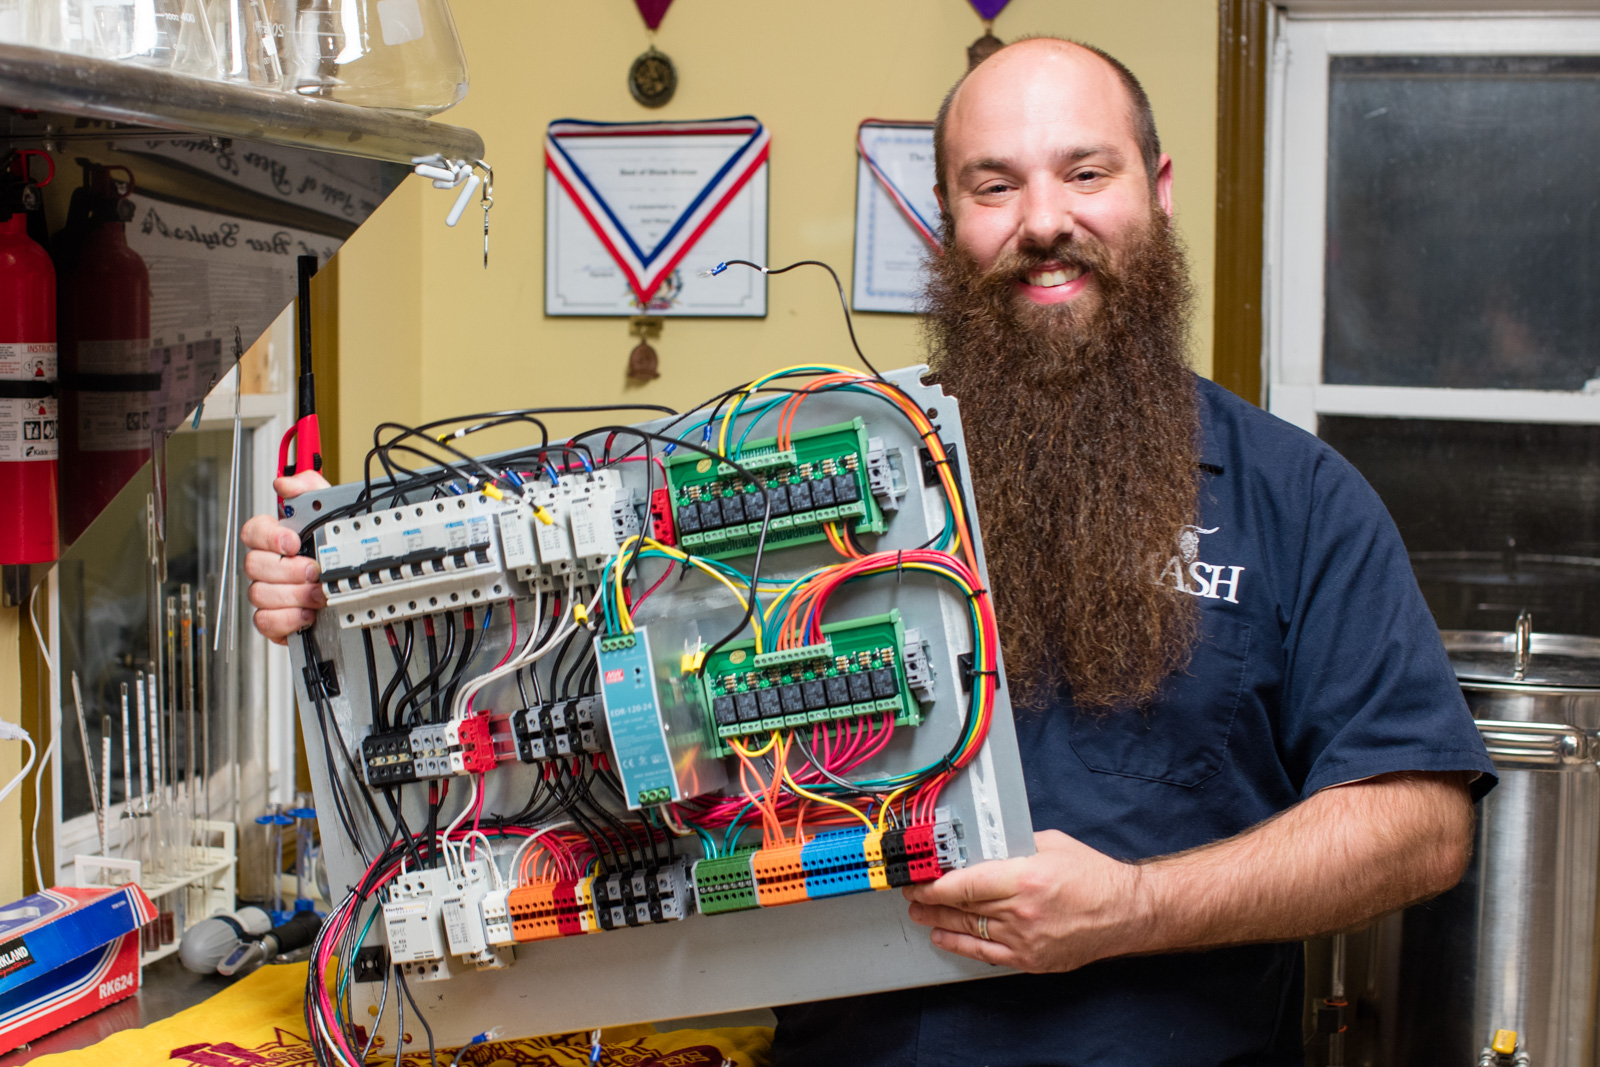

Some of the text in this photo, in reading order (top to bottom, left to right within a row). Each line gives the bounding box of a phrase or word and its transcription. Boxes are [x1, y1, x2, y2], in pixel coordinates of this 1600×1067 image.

[1148, 553, 1246, 604] ASH
[610, 703, 652, 717] EDR-120-24
[99, 972, 134, 999] RK624
